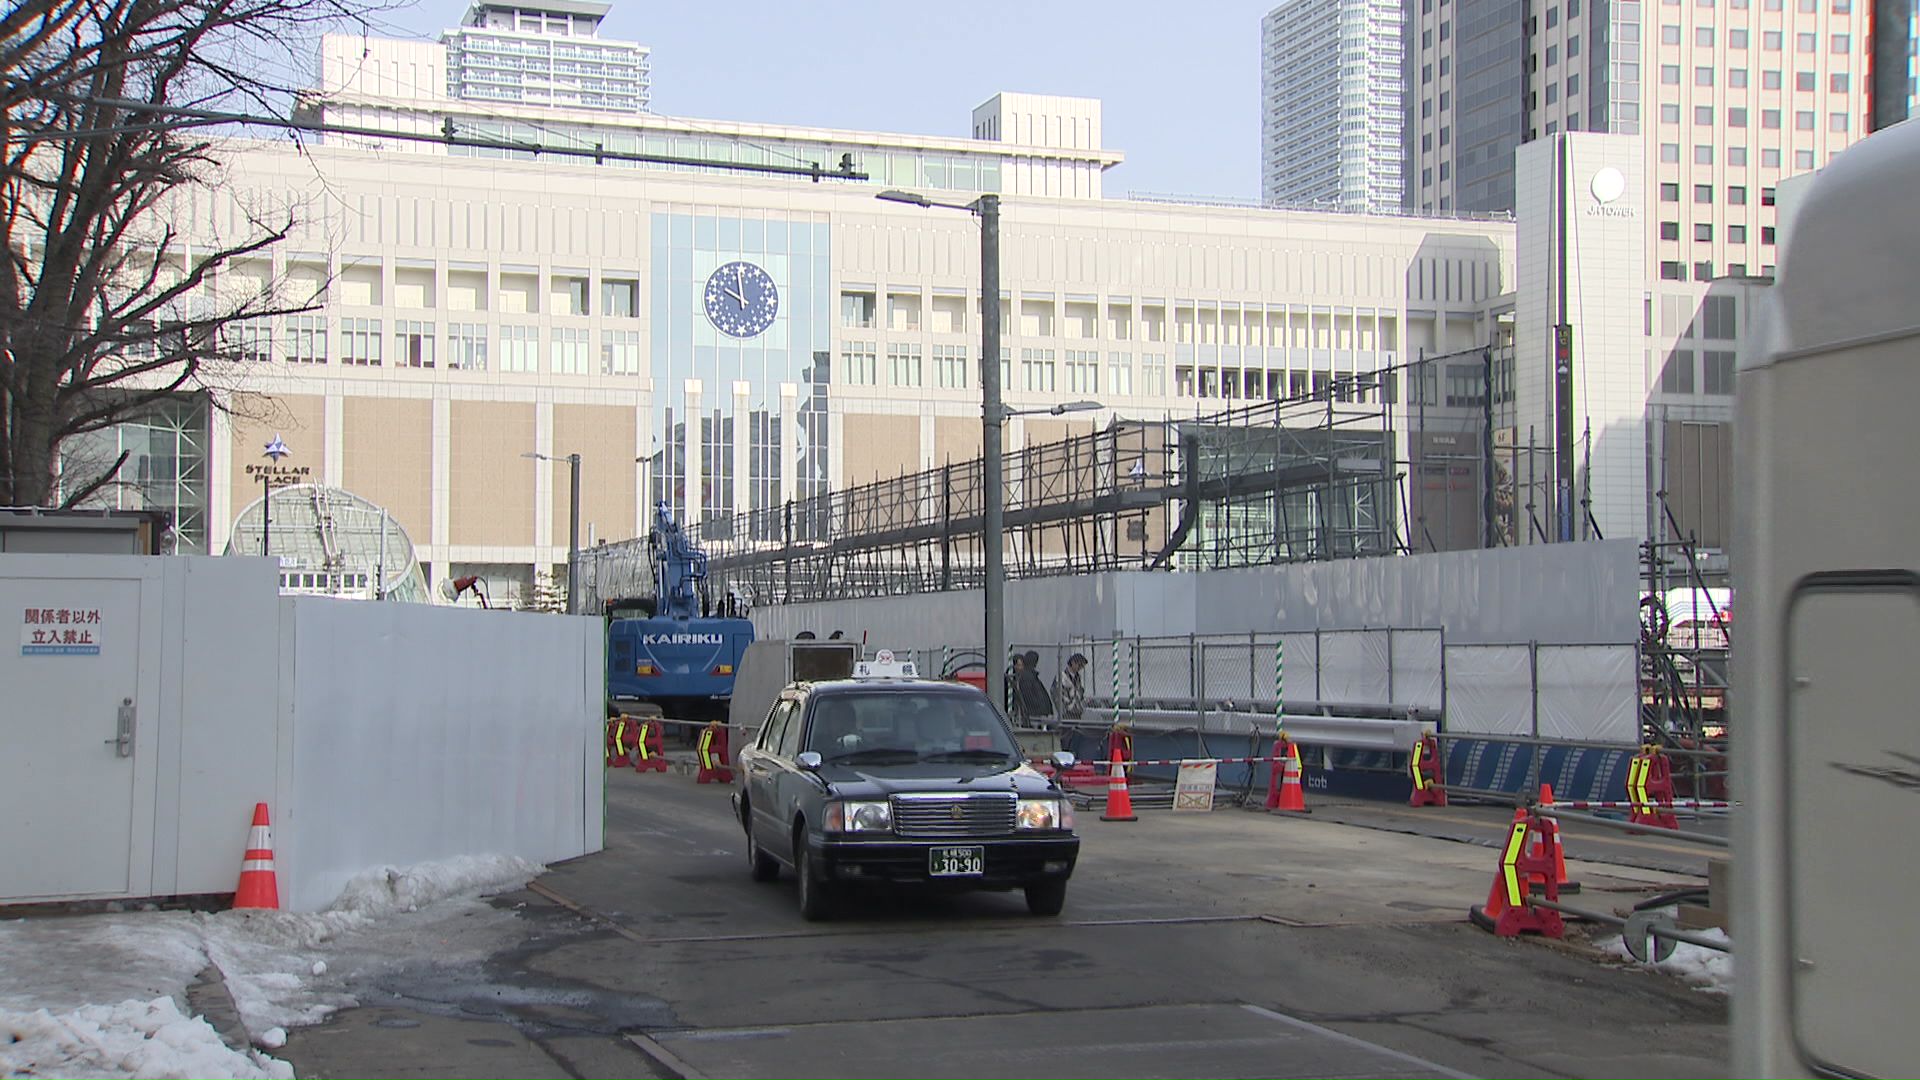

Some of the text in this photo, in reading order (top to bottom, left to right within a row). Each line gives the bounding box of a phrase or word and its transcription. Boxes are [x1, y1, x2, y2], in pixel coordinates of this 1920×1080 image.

[246, 464, 310, 475] STELLAR
[25, 608, 101, 624] 関係者以外
[31, 628, 93, 645] 立入禁止
[643, 633, 723, 645] KAIRIKU
